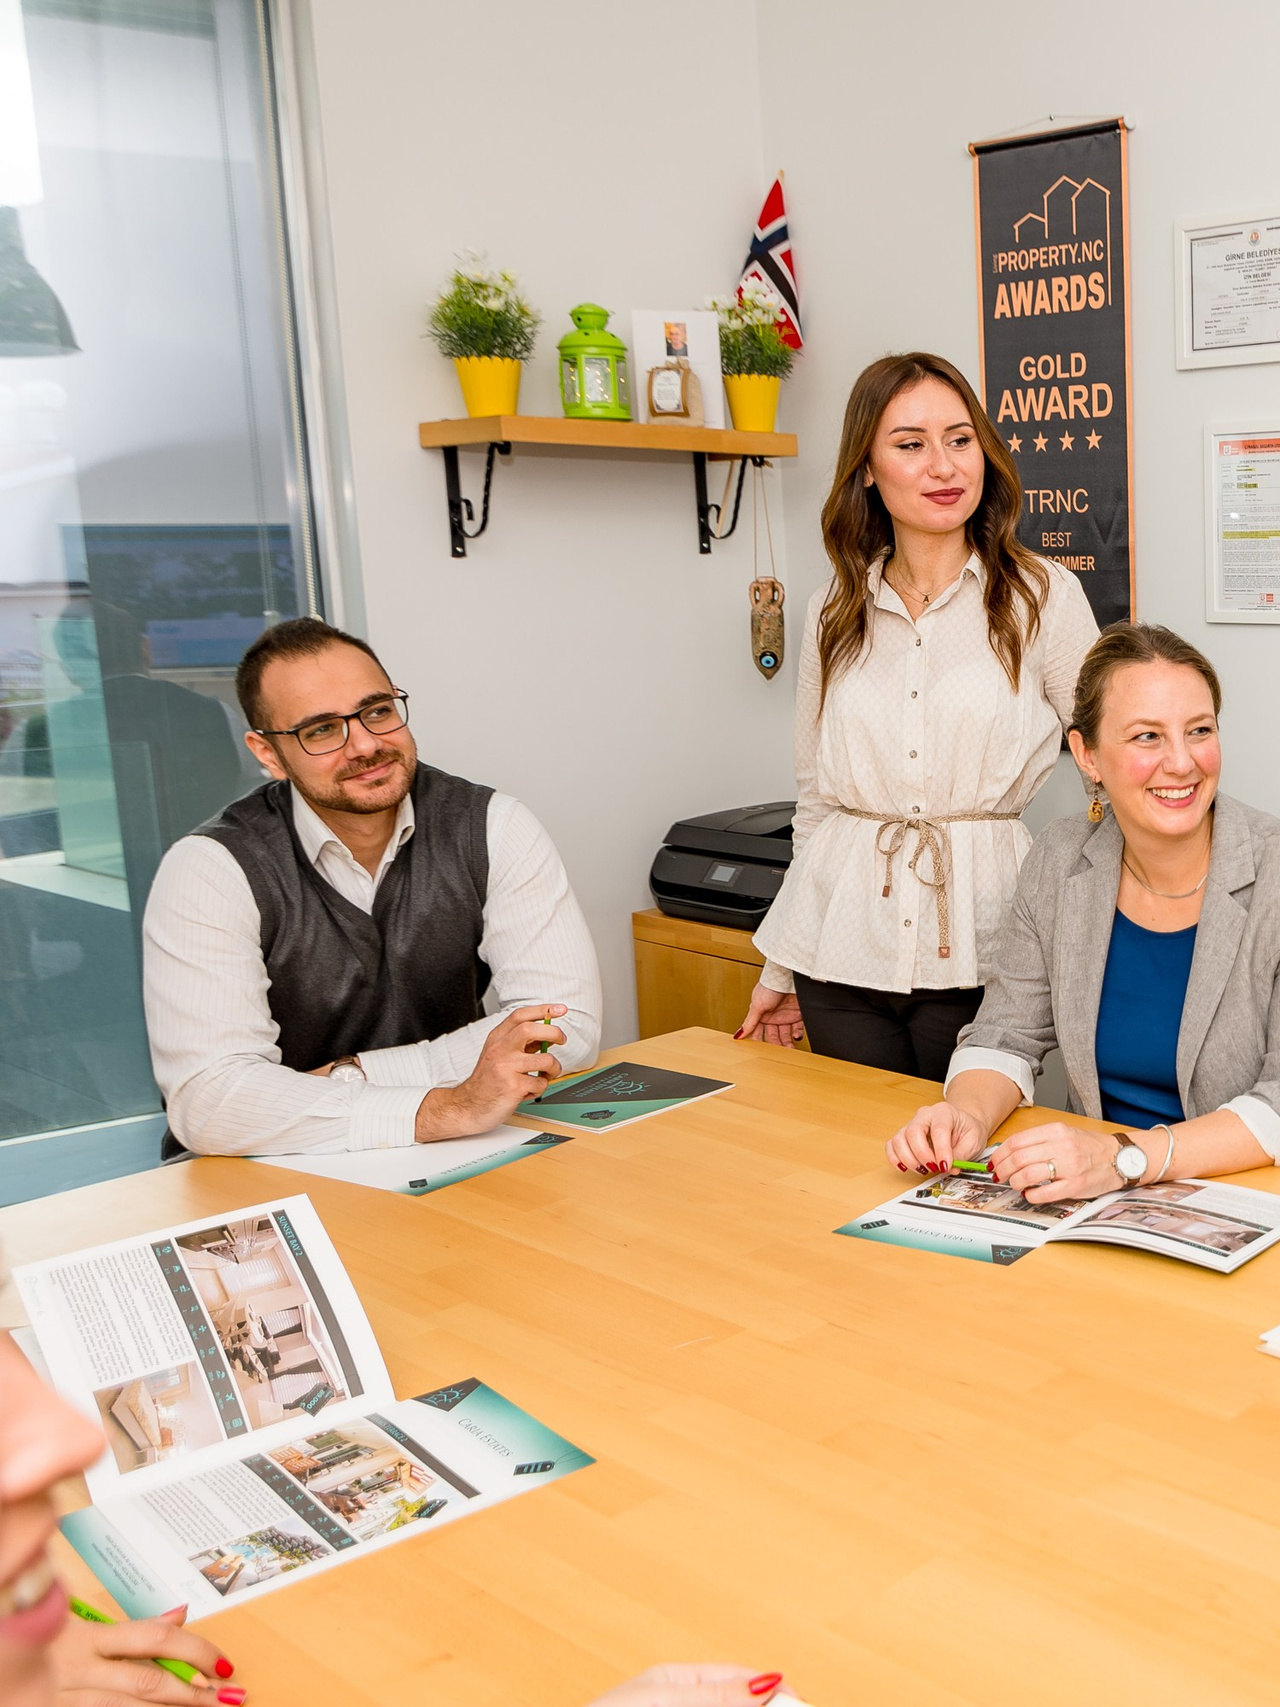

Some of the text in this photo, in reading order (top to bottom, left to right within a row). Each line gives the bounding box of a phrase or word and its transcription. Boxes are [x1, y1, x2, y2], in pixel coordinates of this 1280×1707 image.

[998, 239, 1104, 273] PROPERTY.NC
[994, 271, 1106, 319] AWARDS
[1019, 352, 1087, 381] GOLD
[997, 383, 1113, 423] AWARD
[1024, 488, 1089, 513] TRNC
[1041, 532, 1072, 547] BEST
[277, 1215, 295, 1239] SUNSET
[289, 1238, 301, 1251] BAY
